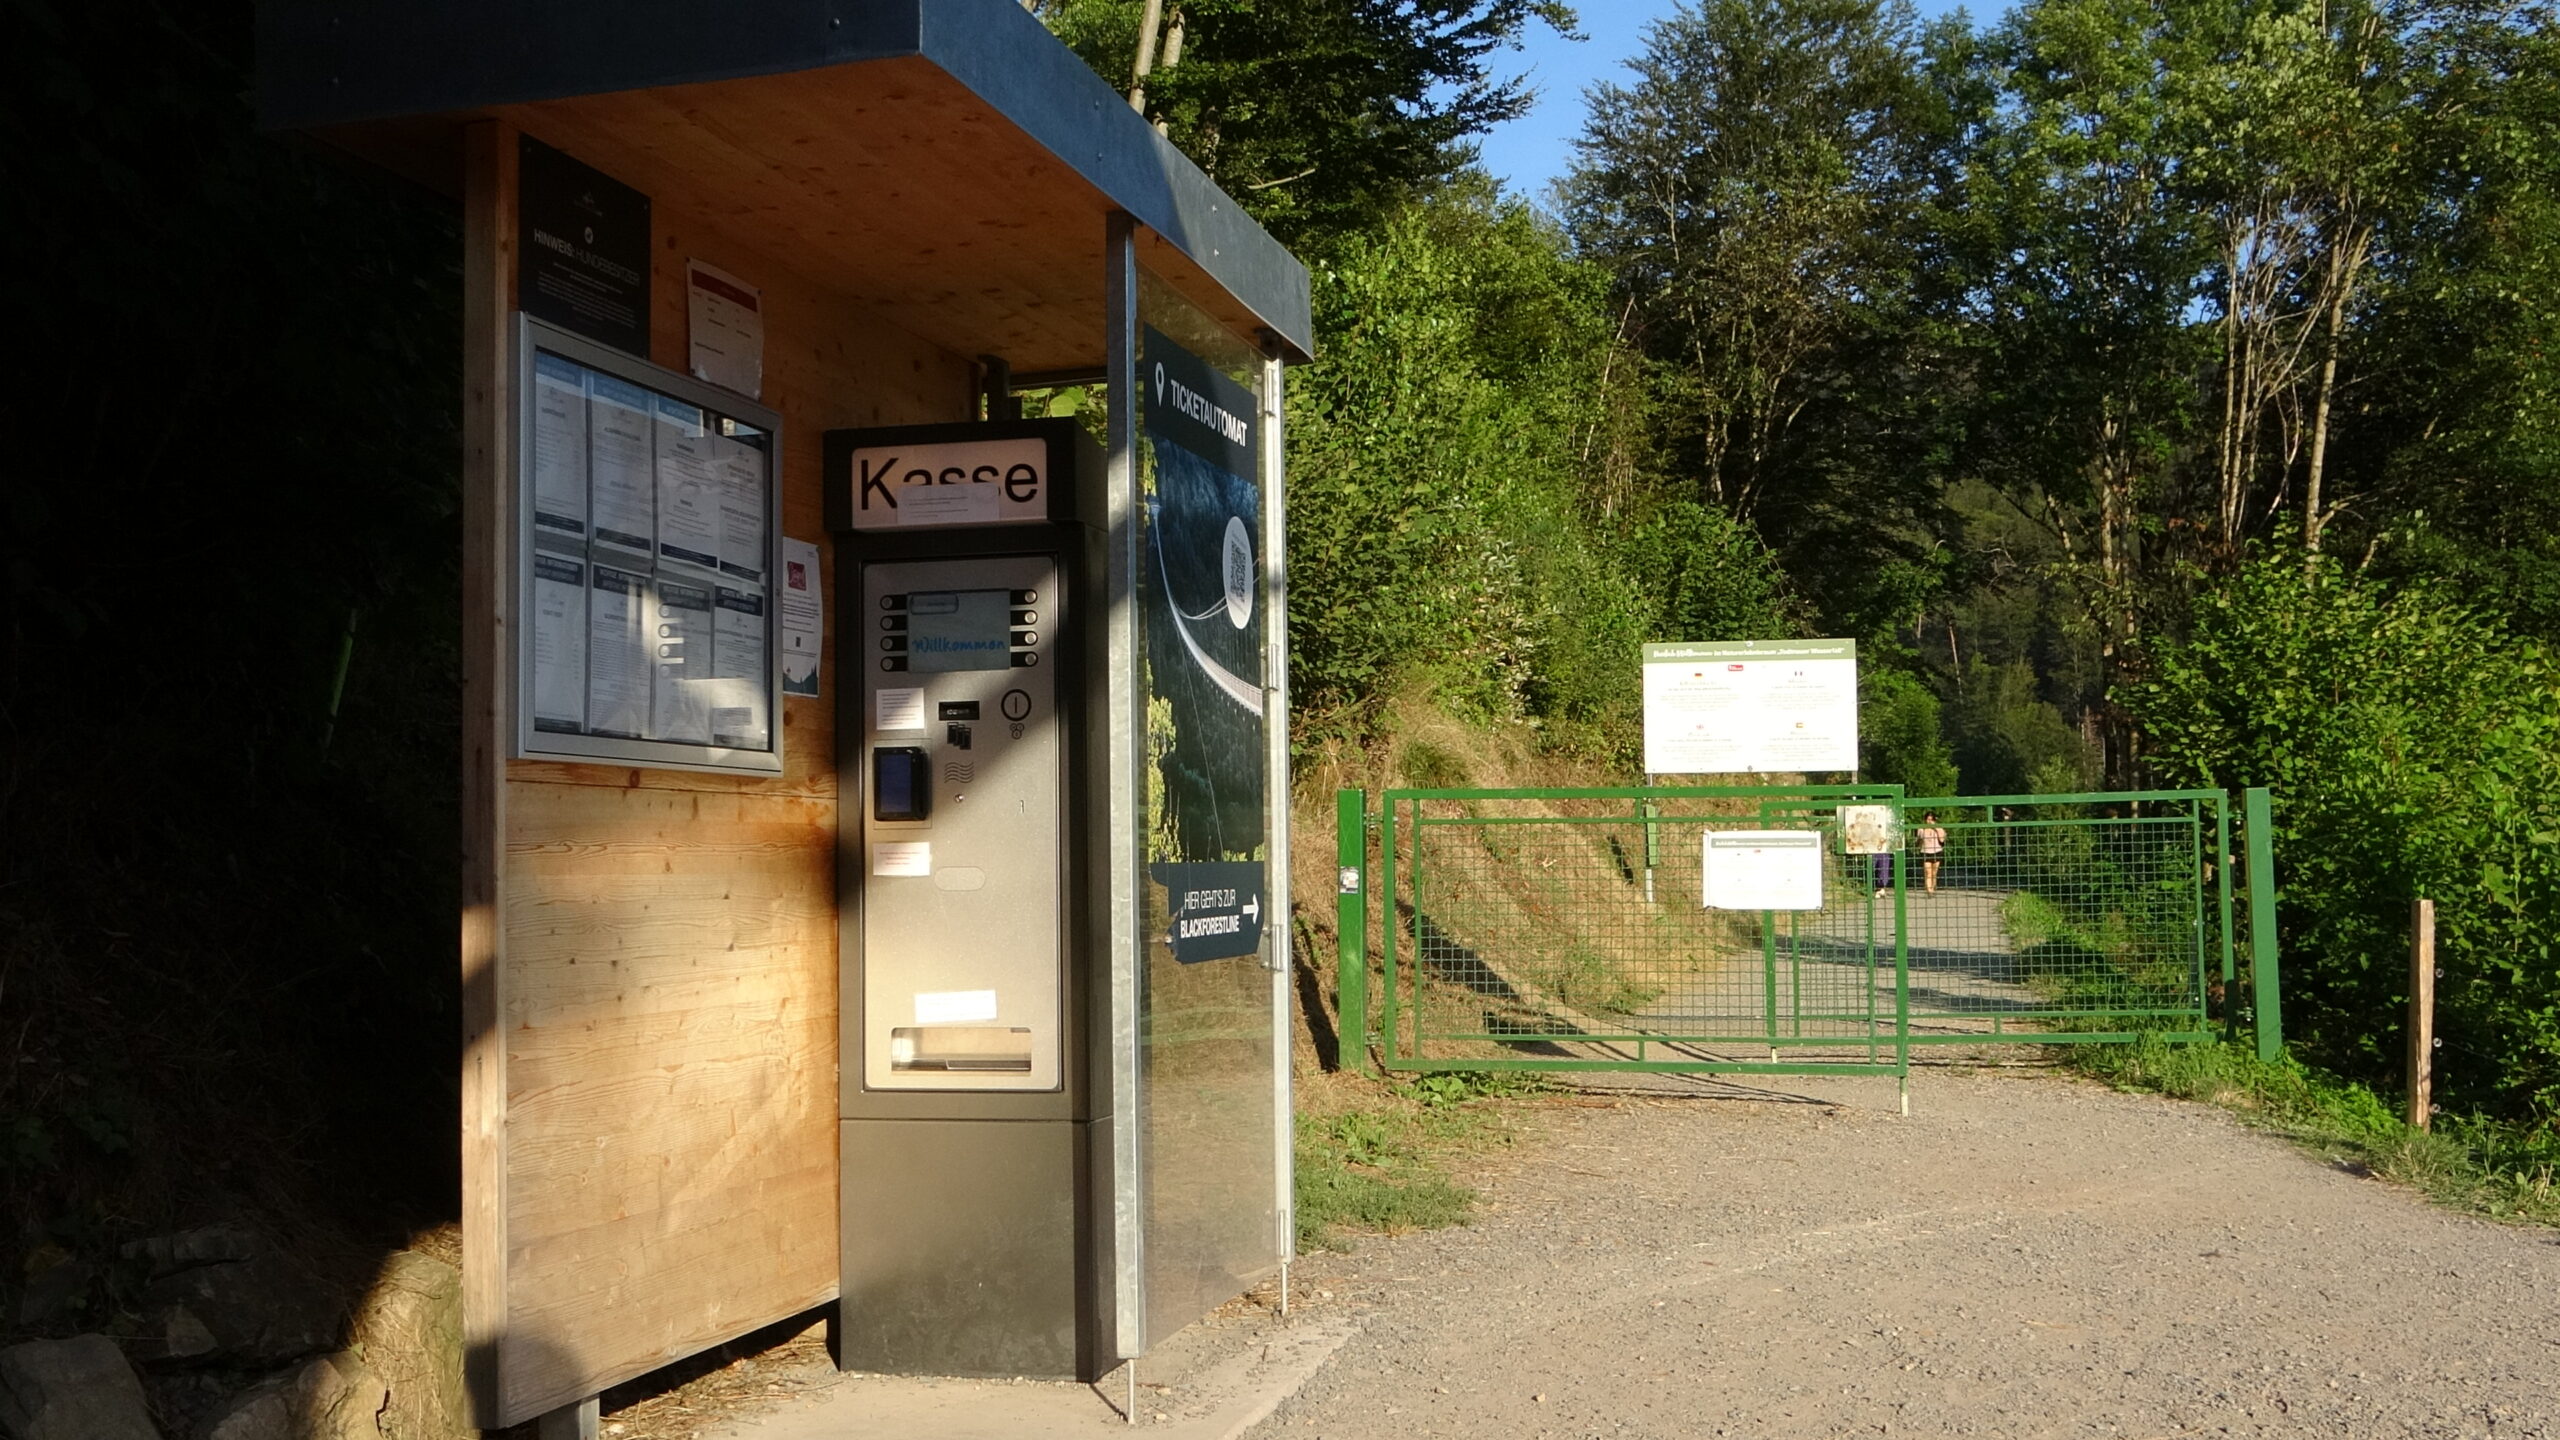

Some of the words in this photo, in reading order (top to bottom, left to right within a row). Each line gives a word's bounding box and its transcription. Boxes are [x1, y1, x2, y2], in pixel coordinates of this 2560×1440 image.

[533, 227, 575, 257] HINWEIS:
[1170, 378, 1248, 447] TICKETAUTOMAT
[1184, 891, 1199, 910] HIER
[1200, 889, 1223, 909] GEHT'S
[1223, 888, 1236, 907] ZUR
[1180, 914, 1240, 939] BLACKFORESTLINE
